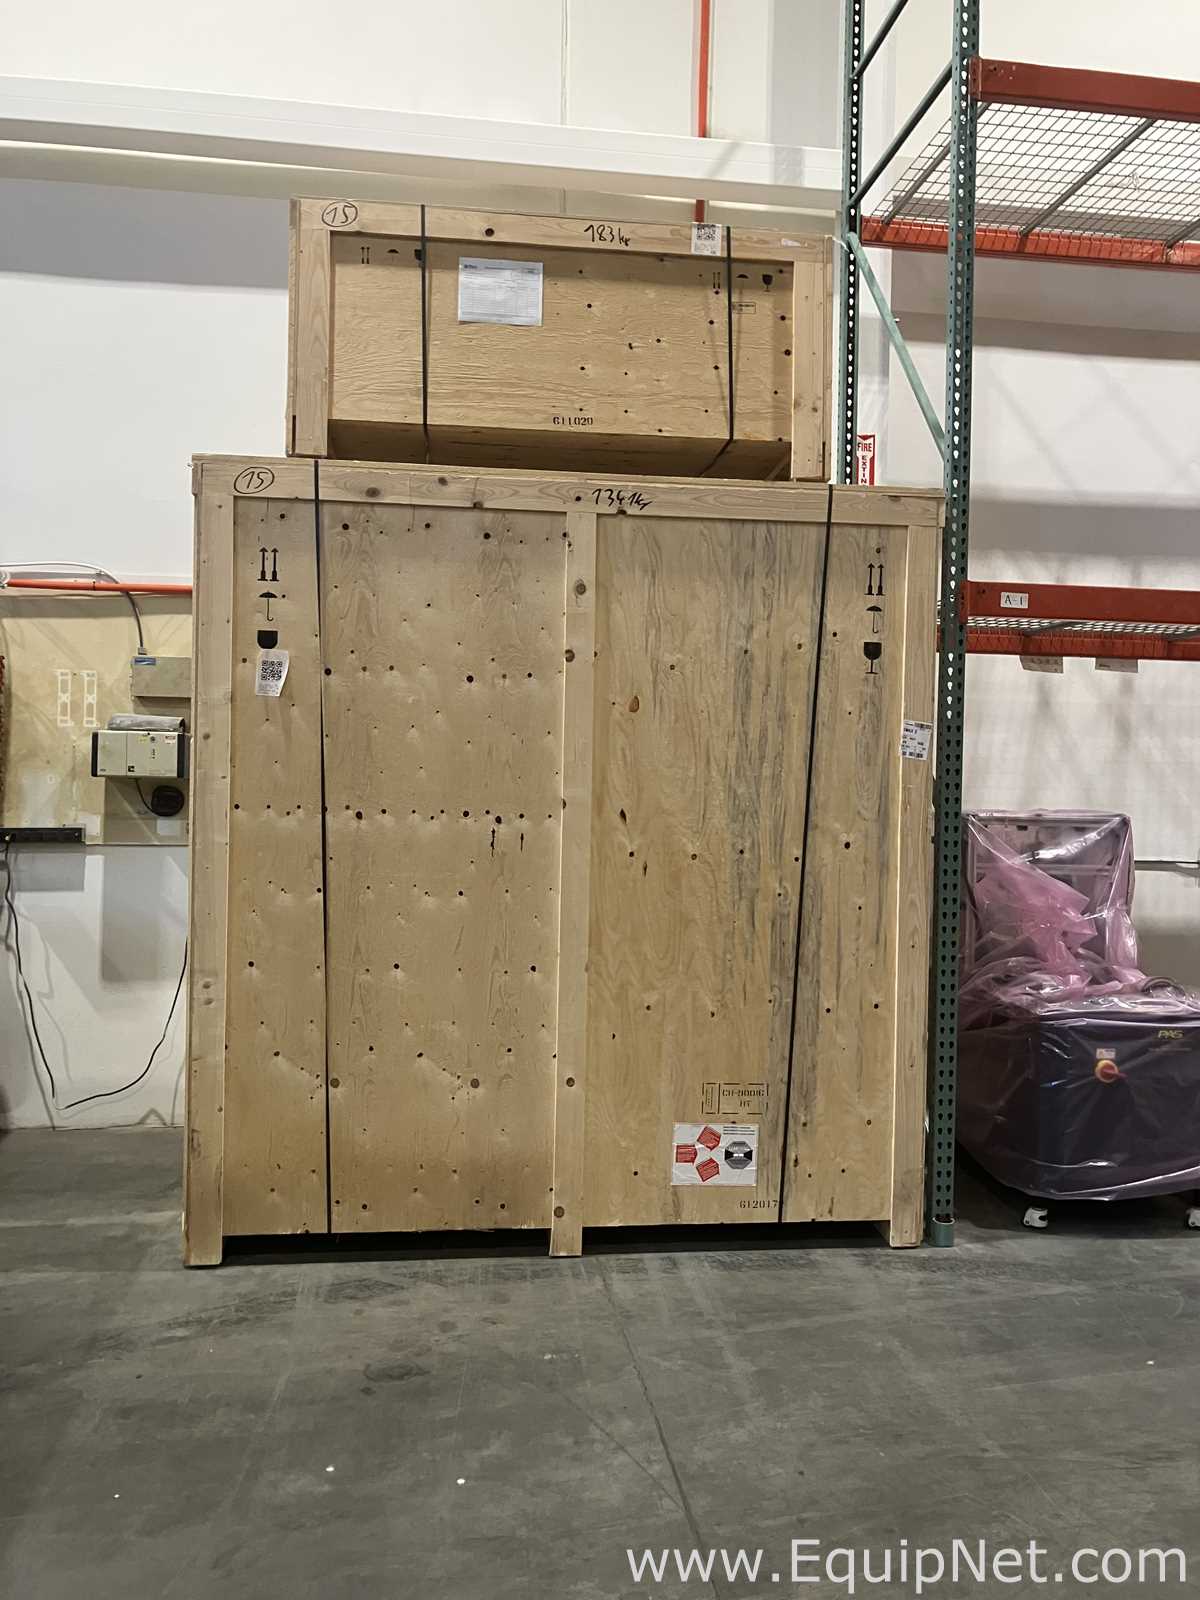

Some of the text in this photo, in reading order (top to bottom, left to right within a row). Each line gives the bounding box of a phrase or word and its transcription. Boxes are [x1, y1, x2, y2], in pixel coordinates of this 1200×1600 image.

[325, 204, 355, 225] 15
[857, 442, 872, 452] FIRE
[241, 470, 270, 490] 15
[1004, 594, 1024, 606] A-1
[738, 1199, 778, 1209] 612017
